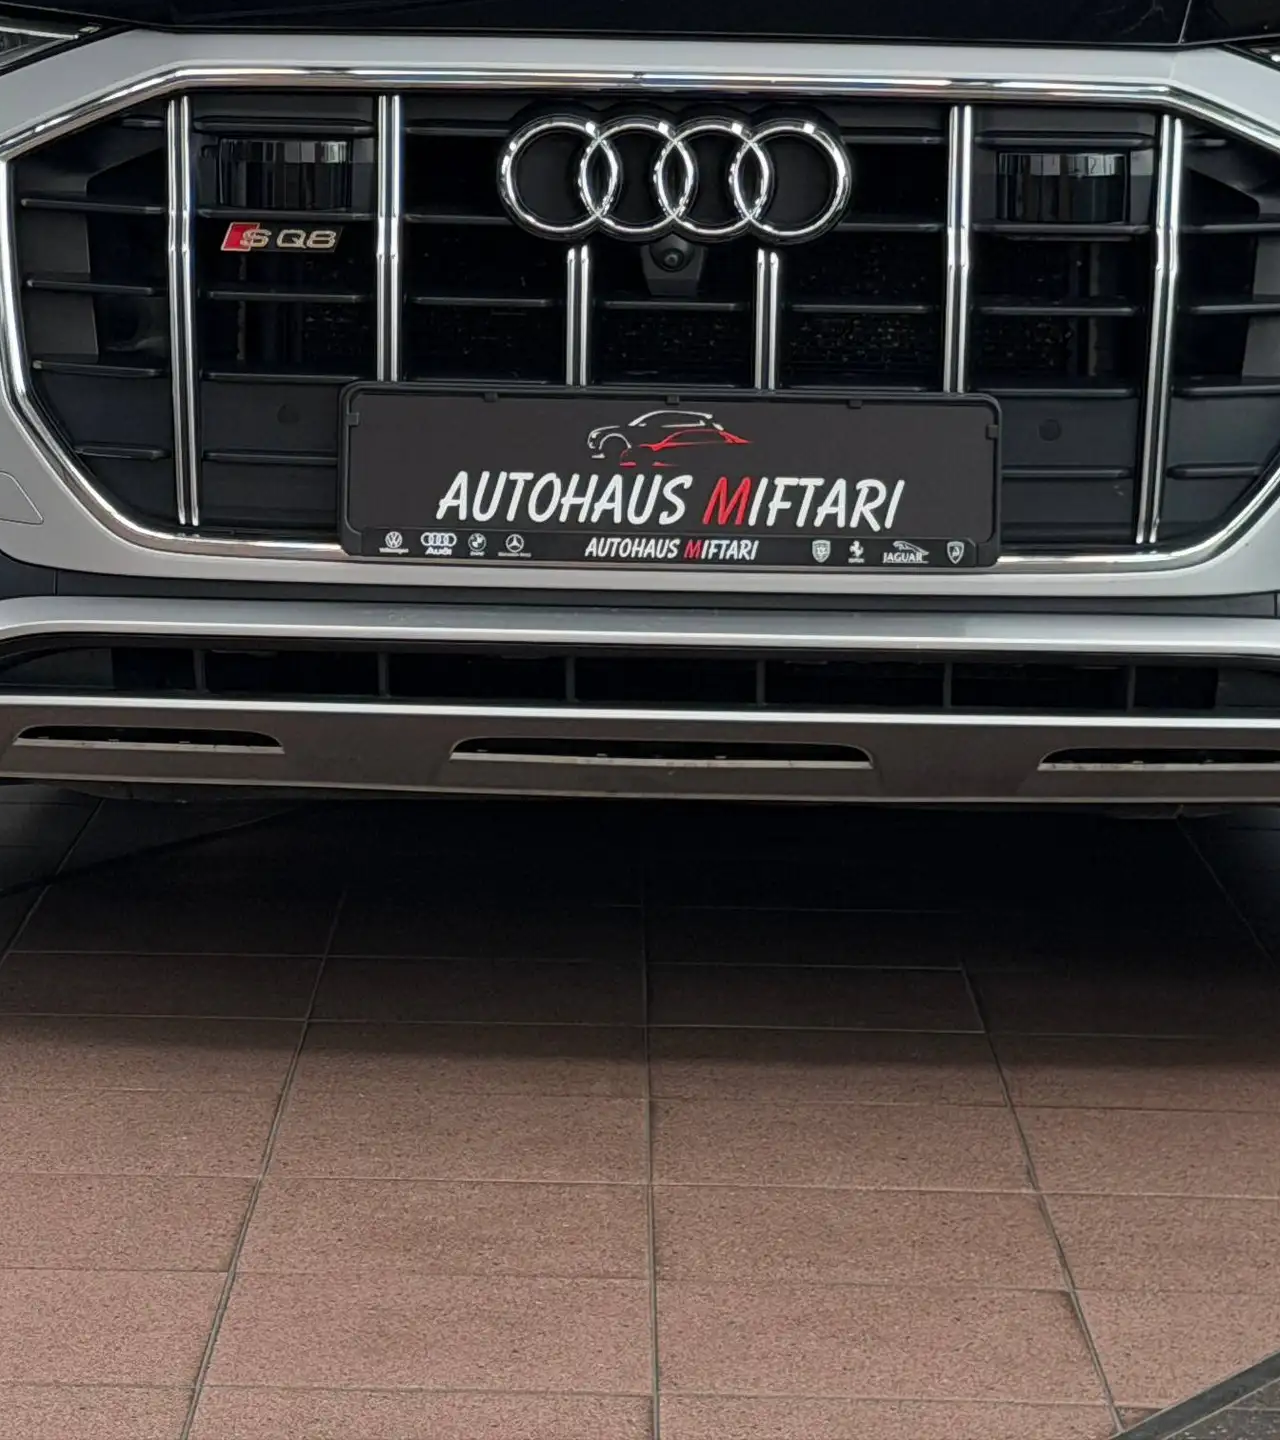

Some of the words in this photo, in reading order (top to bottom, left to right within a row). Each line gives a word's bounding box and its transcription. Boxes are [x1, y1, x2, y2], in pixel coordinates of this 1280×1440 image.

[436, 470, 693, 525] AUTOHAUS
[702, 476, 906, 532] MIFTARI
[425, 546, 452, 555] Audi
[584, 537, 681, 559] AUTOHAUS
[683, 539, 760, 560] MIFTARI
[883, 552, 924, 563] JAGUAR
